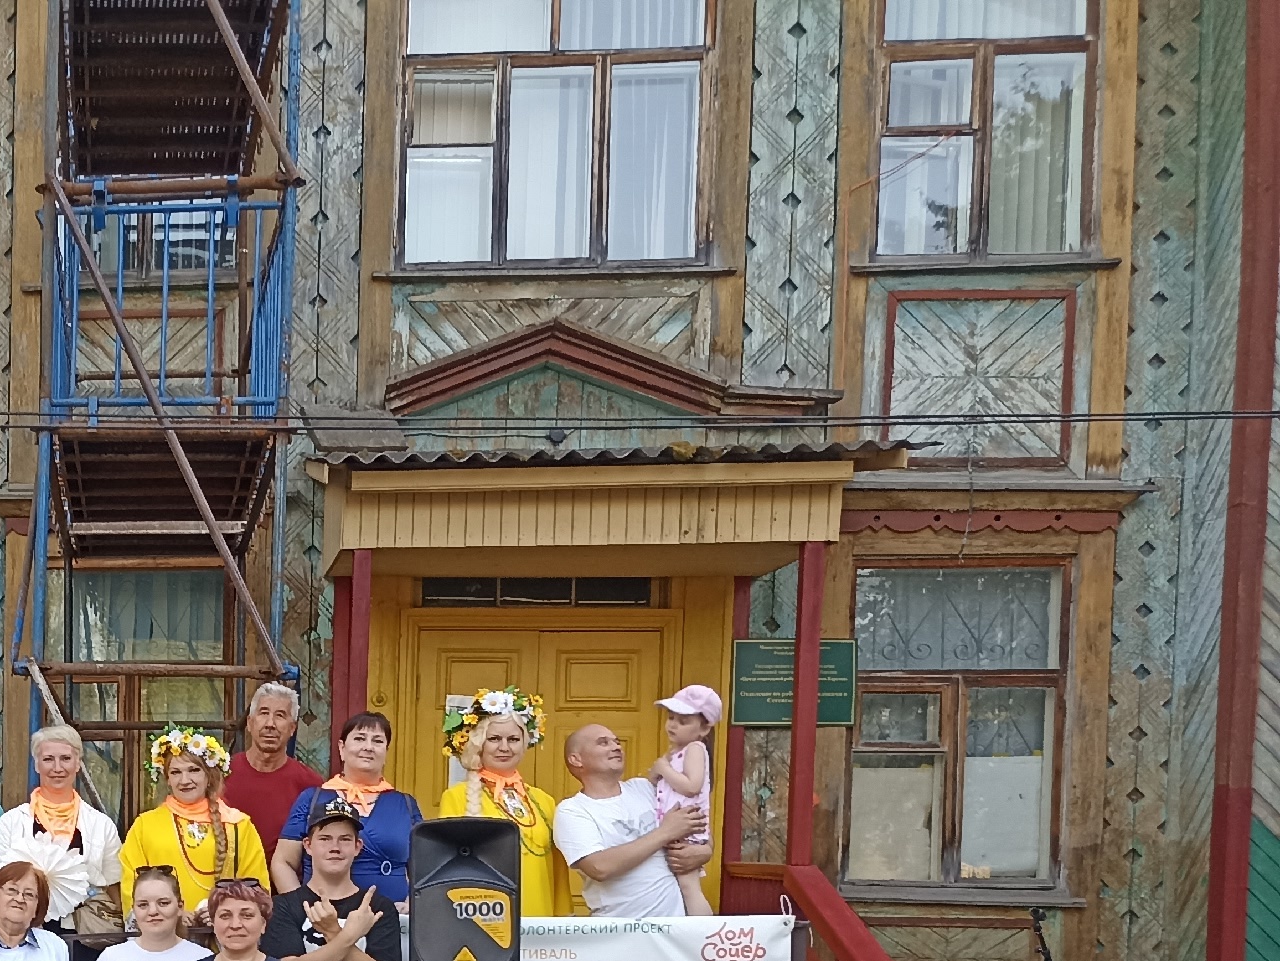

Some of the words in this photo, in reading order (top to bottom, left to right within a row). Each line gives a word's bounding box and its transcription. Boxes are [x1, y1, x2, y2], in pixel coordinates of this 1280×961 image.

[455, 901, 504, 917] 1000
[519, 922, 618, 936] ОЛОНТЕРСКИЙ
[623, 922, 673, 935] ПРОЕКТ
[705, 921, 755, 944] Том
[521, 948, 577, 960] ТИВАЛЬ
